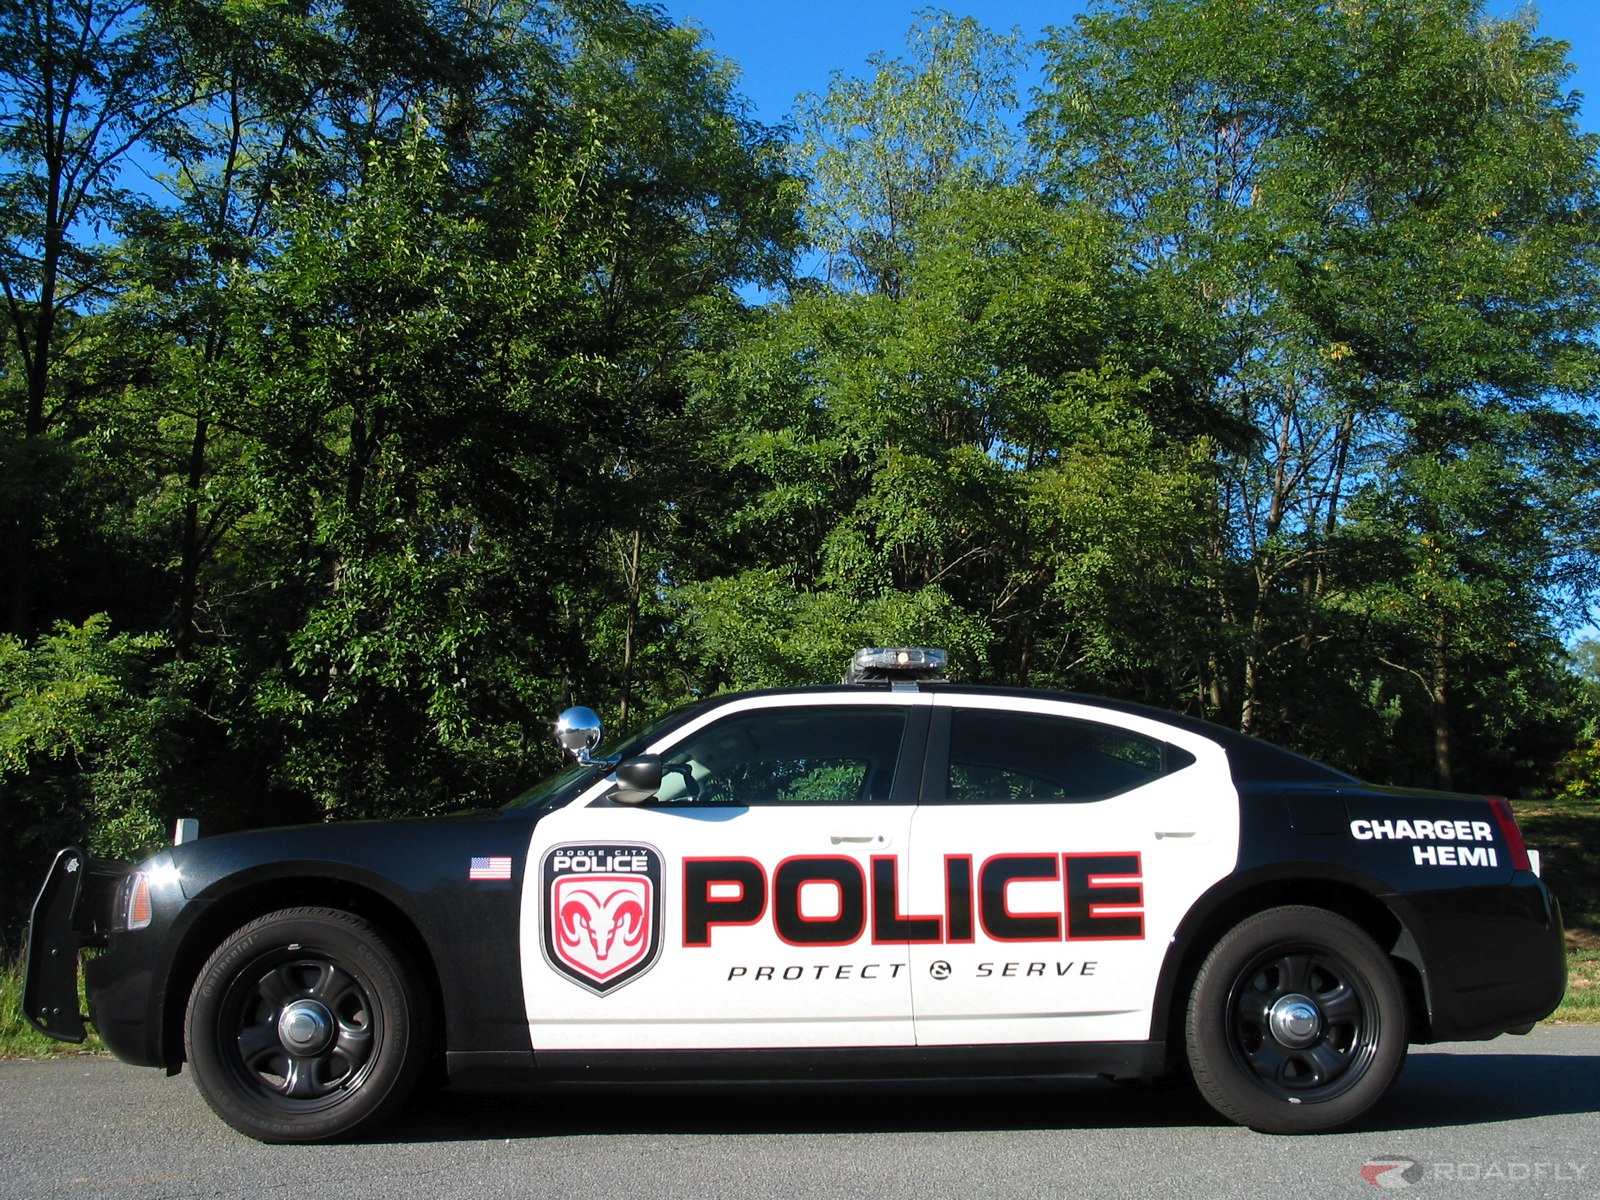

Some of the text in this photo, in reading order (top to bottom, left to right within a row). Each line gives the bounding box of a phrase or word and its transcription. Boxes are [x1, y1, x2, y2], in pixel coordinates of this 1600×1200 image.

[1350, 819, 1493, 841] CHARGER
[553, 856, 648, 872] POLICE
[1412, 846, 1498, 867] HEMI
[681, 851, 1145, 948] POLICE
[727, 960, 1099, 981] PROTECT & SERVE
